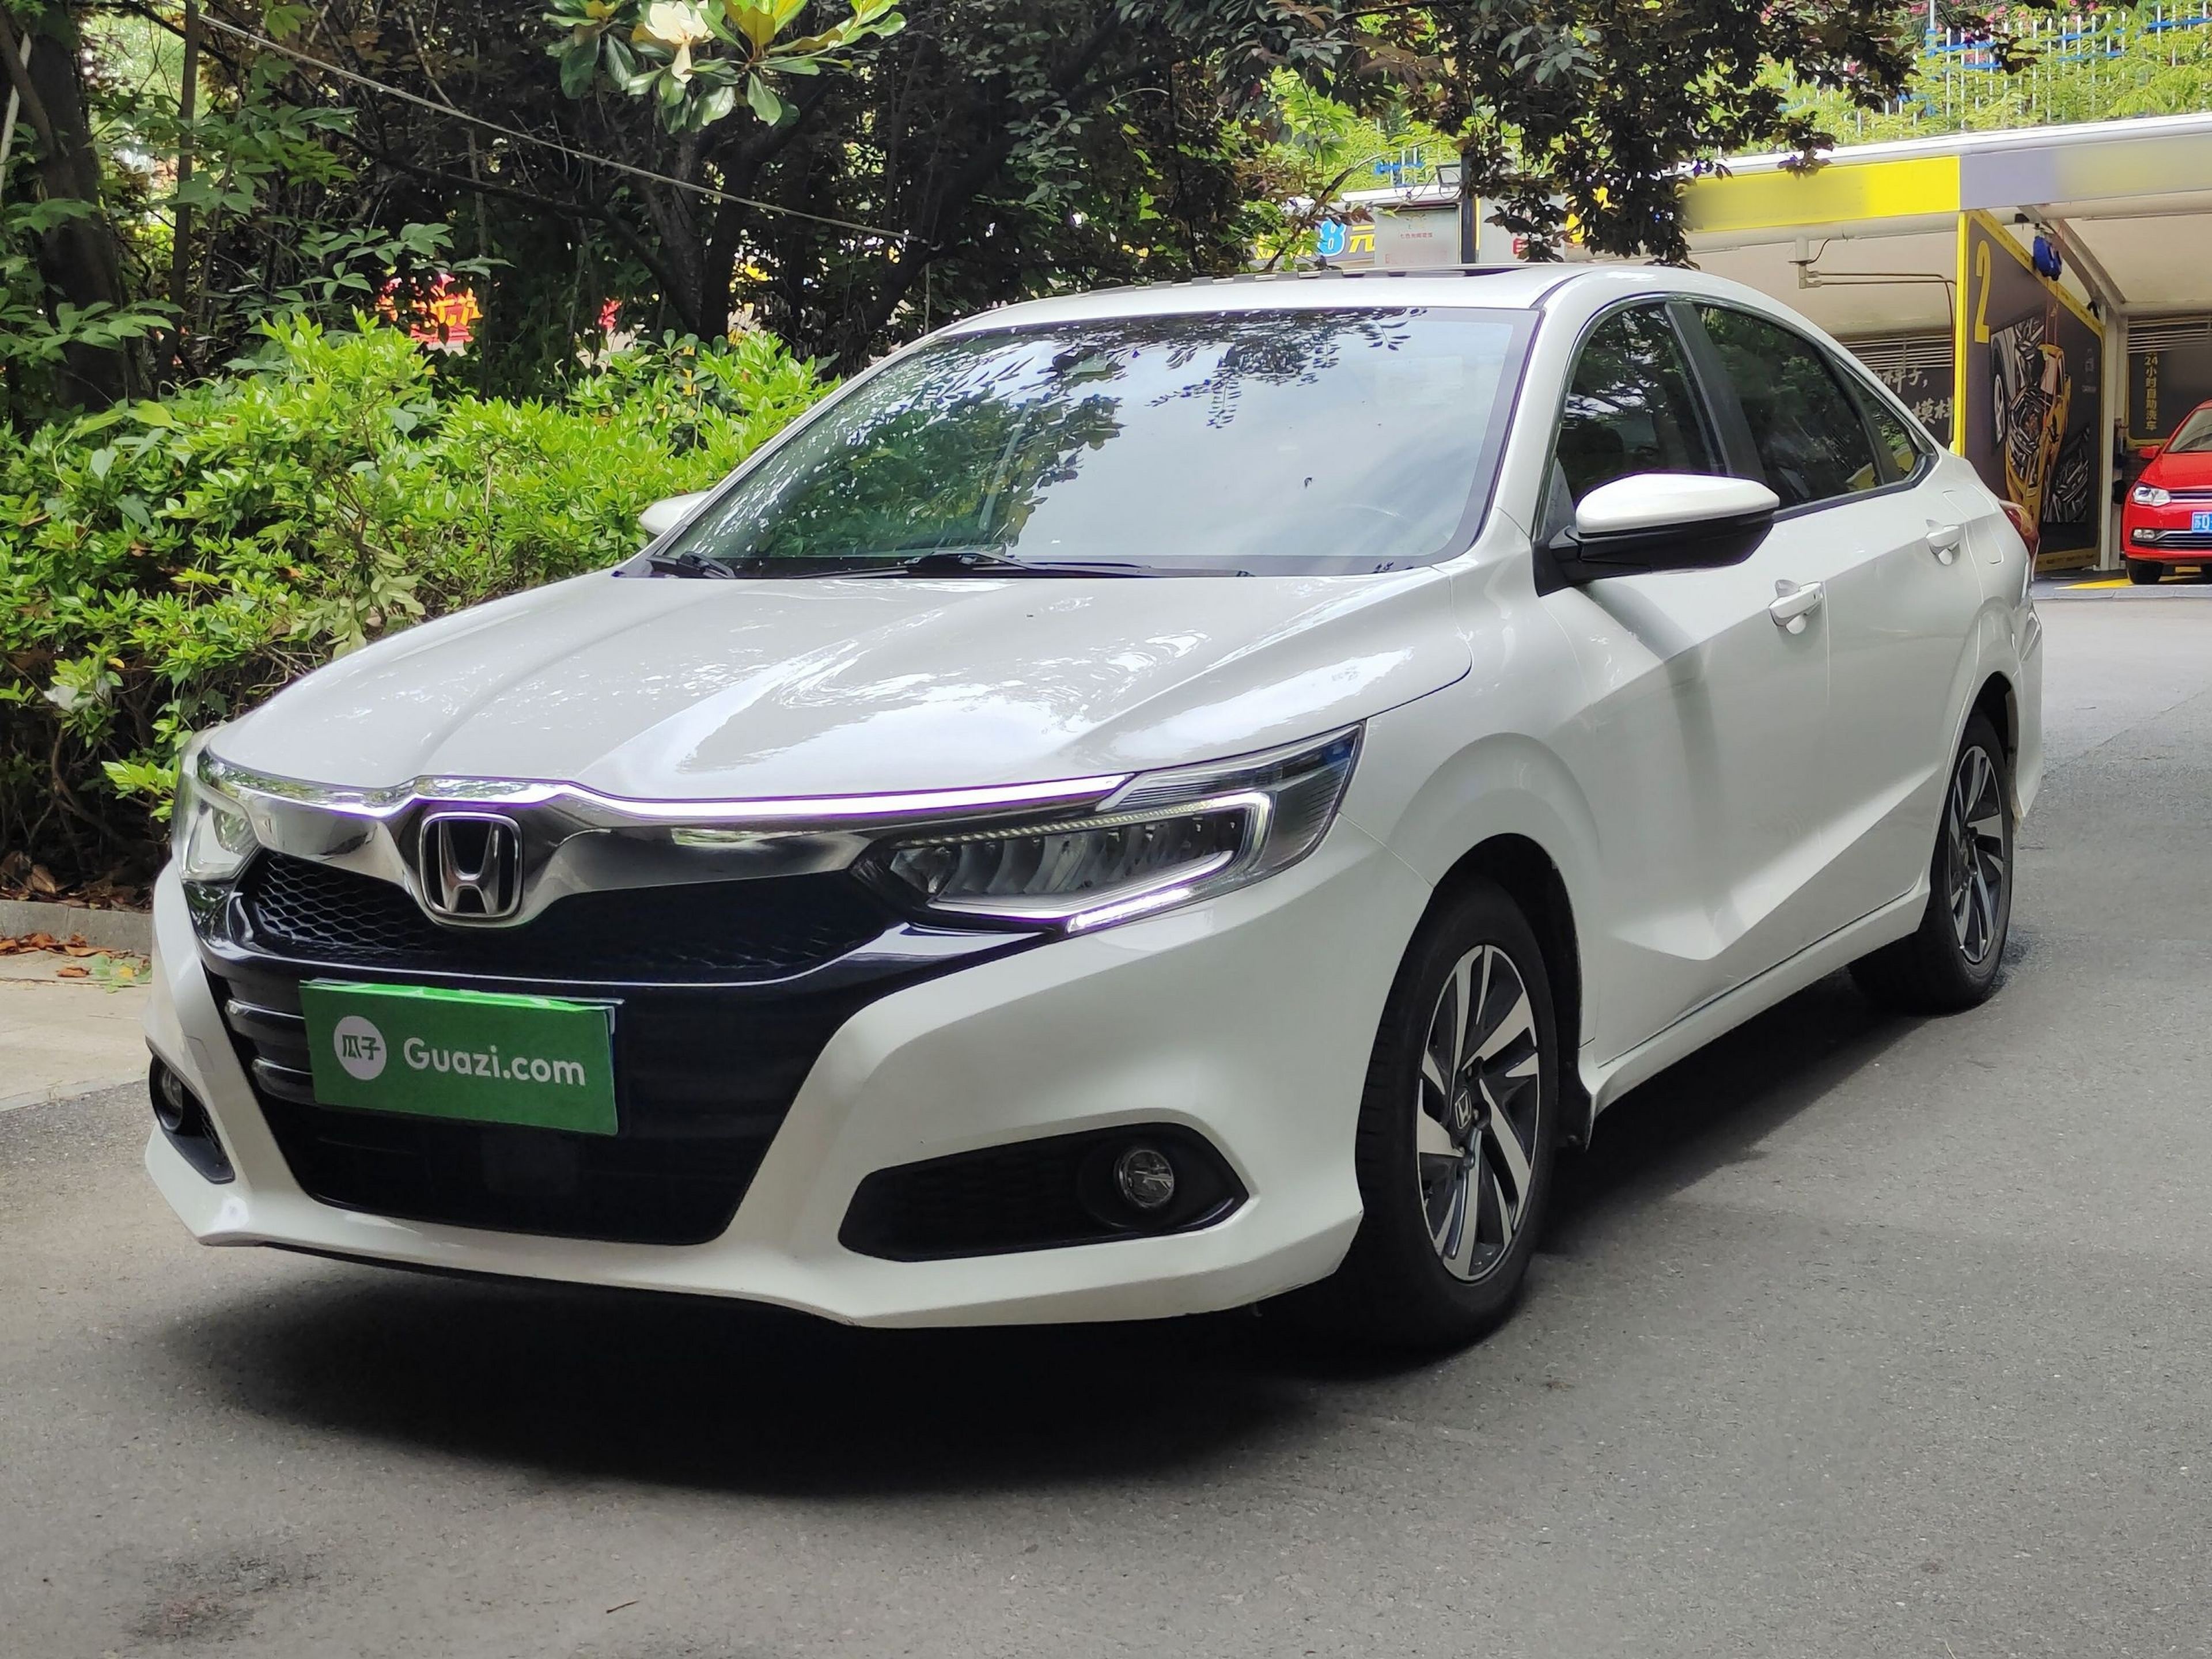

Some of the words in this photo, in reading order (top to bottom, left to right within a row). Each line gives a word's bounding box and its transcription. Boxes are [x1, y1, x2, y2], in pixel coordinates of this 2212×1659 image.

[1975, 240, 1991, 343] 2
[342, 1033, 381, 1060] 瓜子
[404, 1037, 585, 1086] Guazi.com
